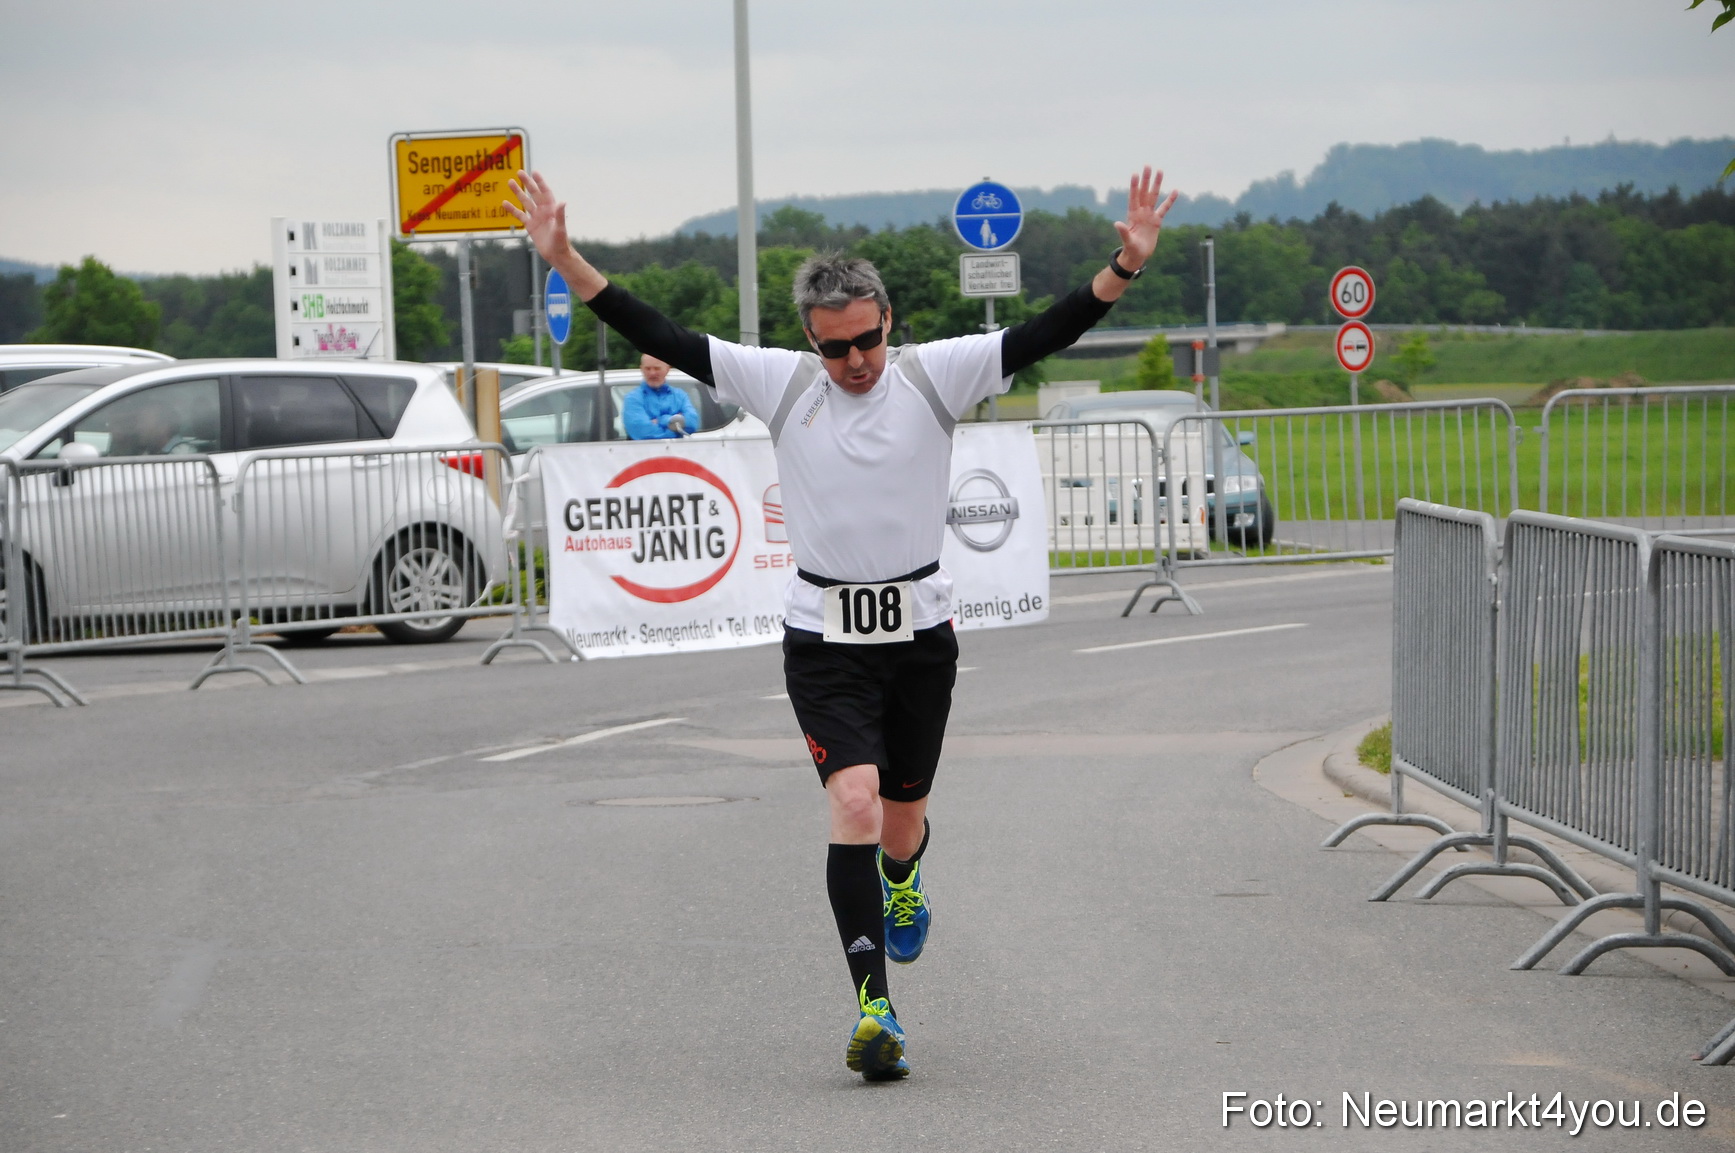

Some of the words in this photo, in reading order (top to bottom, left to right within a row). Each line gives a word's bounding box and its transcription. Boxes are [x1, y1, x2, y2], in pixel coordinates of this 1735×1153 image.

[408, 147, 512, 179] Sengenthal
[423, 183, 445, 195] am
[453, 180, 498, 197] Anger
[435, 208, 481, 221] Neumarkt
[971, 259, 1008, 269] Landwirt-
[1341, 281, 1365, 304] 60
[302, 293, 325, 320] SHB
[564, 492, 704, 532] GERHART
[708, 499, 720, 517] &
[952, 502, 1012, 520] NISSAN
[564, 534, 633, 553] Autohaus
[632, 525, 726, 564] JÄNIG
[838, 584, 902, 635] 108
[566, 626, 629, 649] Neumarkt
[639, 618, 715, 649] Sengenthal
[726, 615, 752, 637] Tel.
[847, 943, 876, 954] adidas
